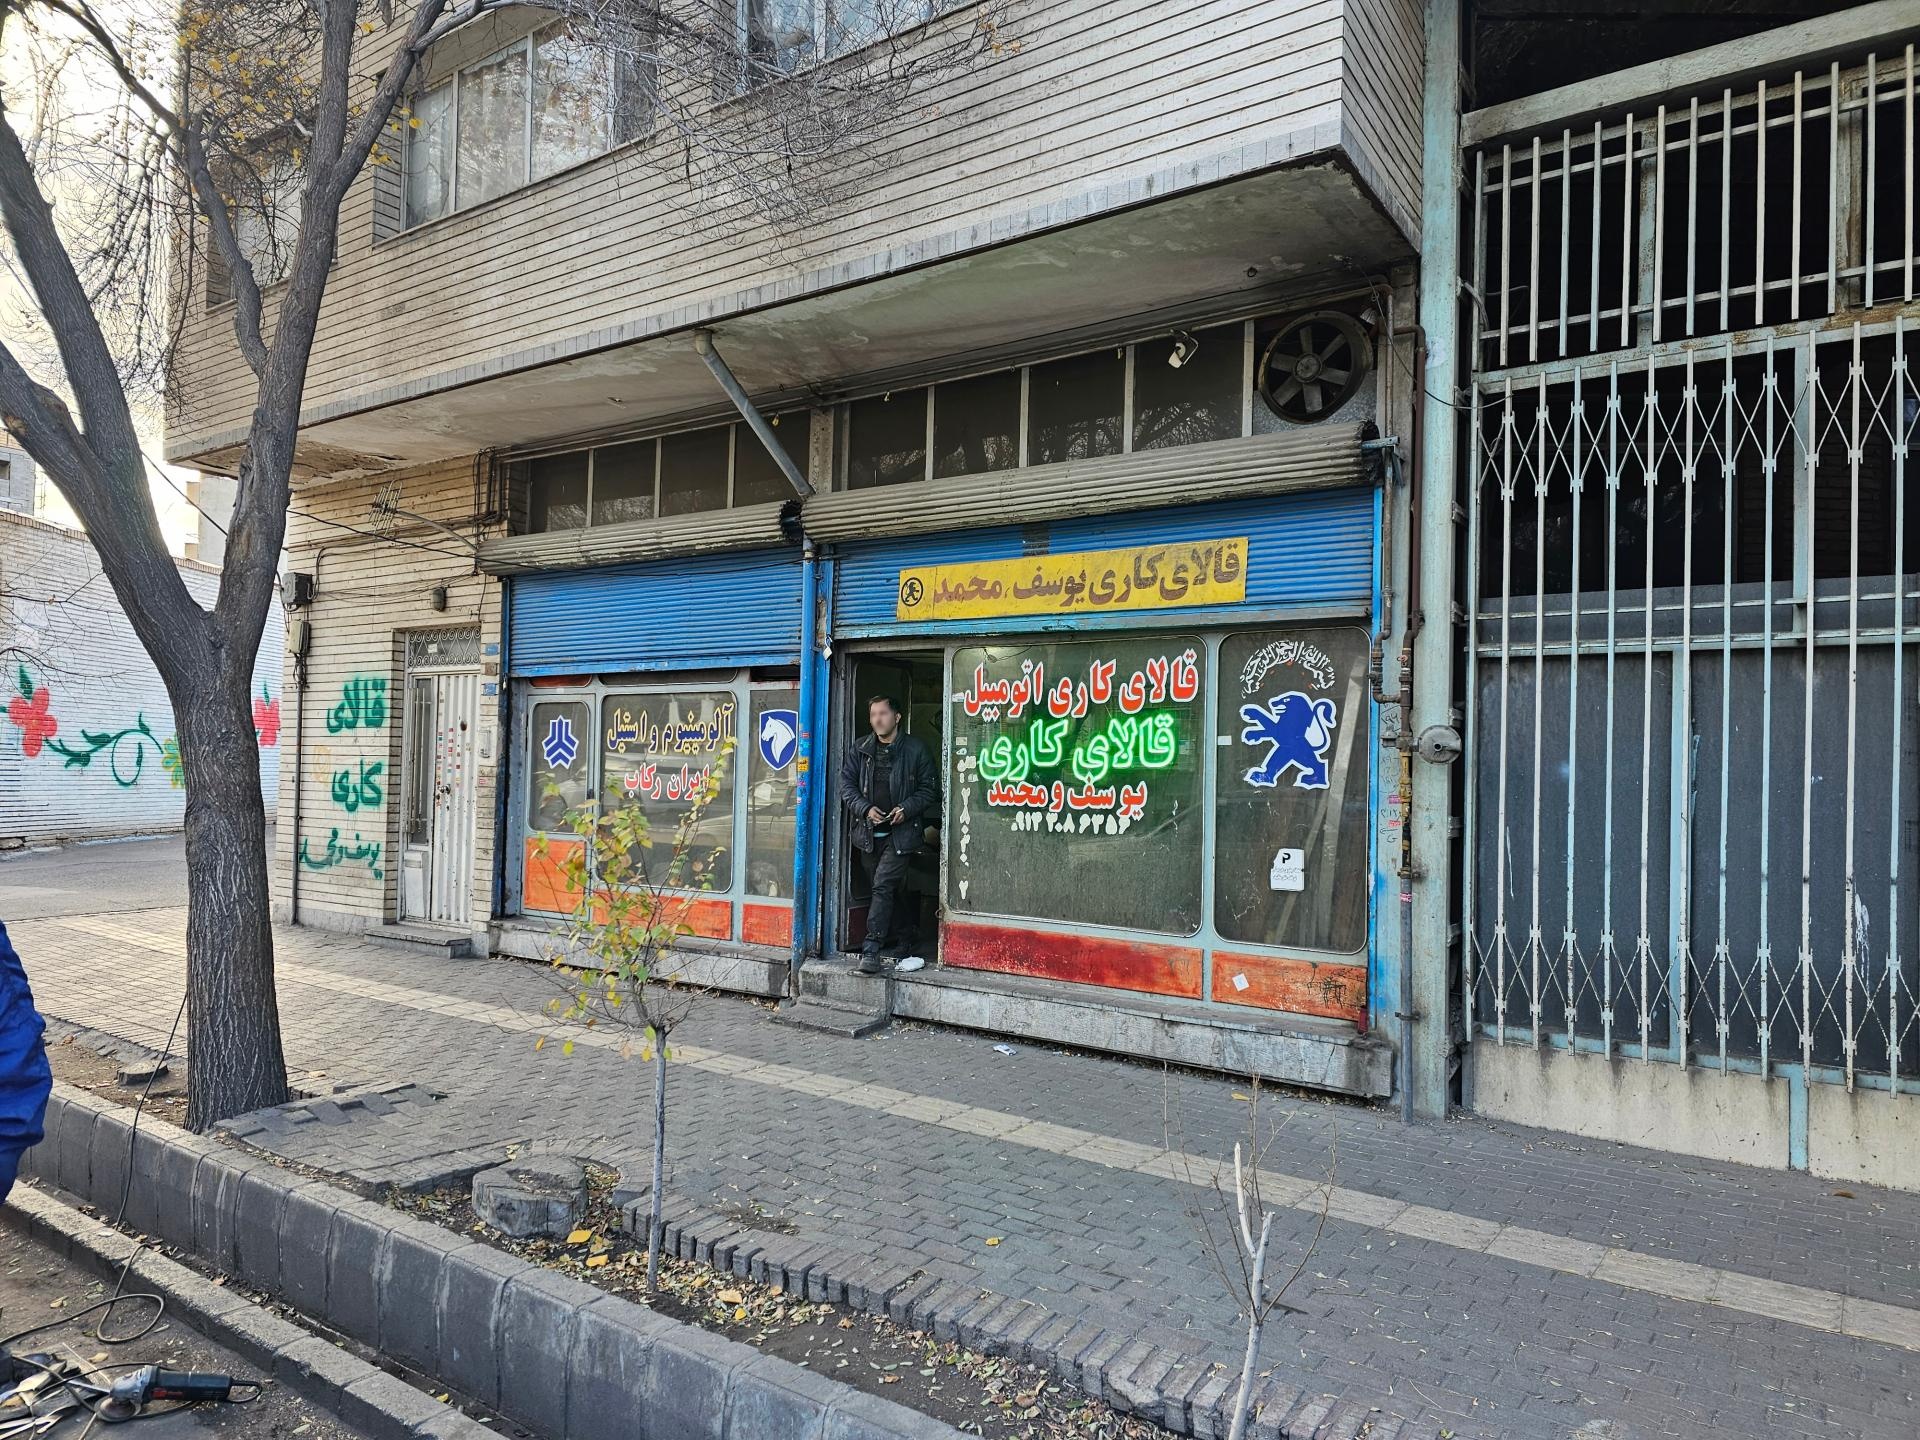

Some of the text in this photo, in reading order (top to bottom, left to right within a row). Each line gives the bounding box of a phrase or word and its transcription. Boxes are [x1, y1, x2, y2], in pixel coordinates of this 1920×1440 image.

[933, 543, 1240, 608] قالای کاری یوسف محمد
[326, 677, 386, 734] قالای
[963, 648, 1199, 723] قالای کاری اتومبیل
[606, 707, 649, 755] استیل
[977, 718, 1069, 782] کاری
[1071, 712, 1176, 783] قالای
[331, 757, 384, 813] کاری
[986, 771, 1148, 822] یوسف و محمد
